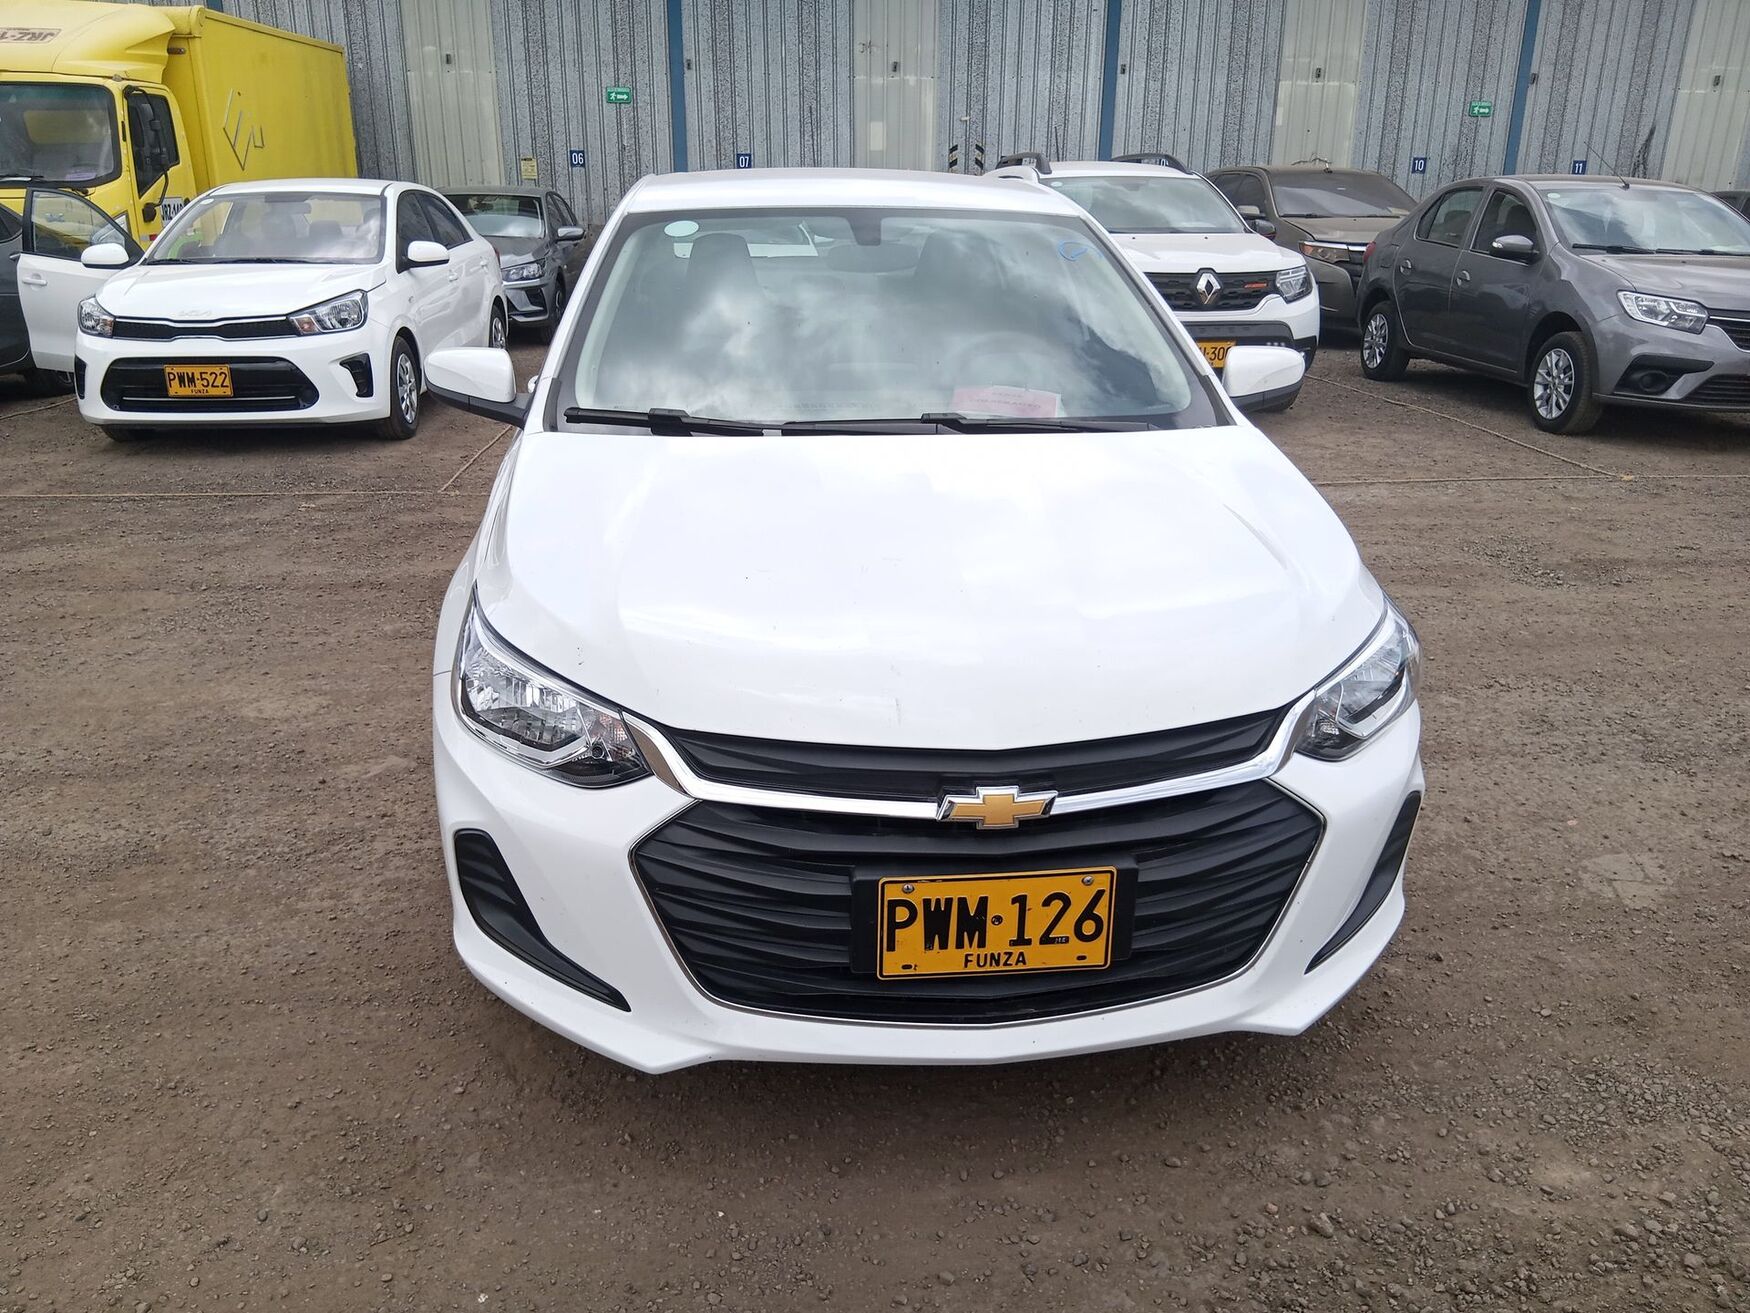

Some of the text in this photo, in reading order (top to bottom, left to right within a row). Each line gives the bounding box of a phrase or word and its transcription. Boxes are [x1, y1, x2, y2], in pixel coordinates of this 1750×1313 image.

[572, 153, 583, 164] 06
[740, 156, 749, 167] 07
[1415, 160, 1424, 170] 10
[1575, 163, 1583, 173] 11
[964, 952, 1027, 968] FUNZA
